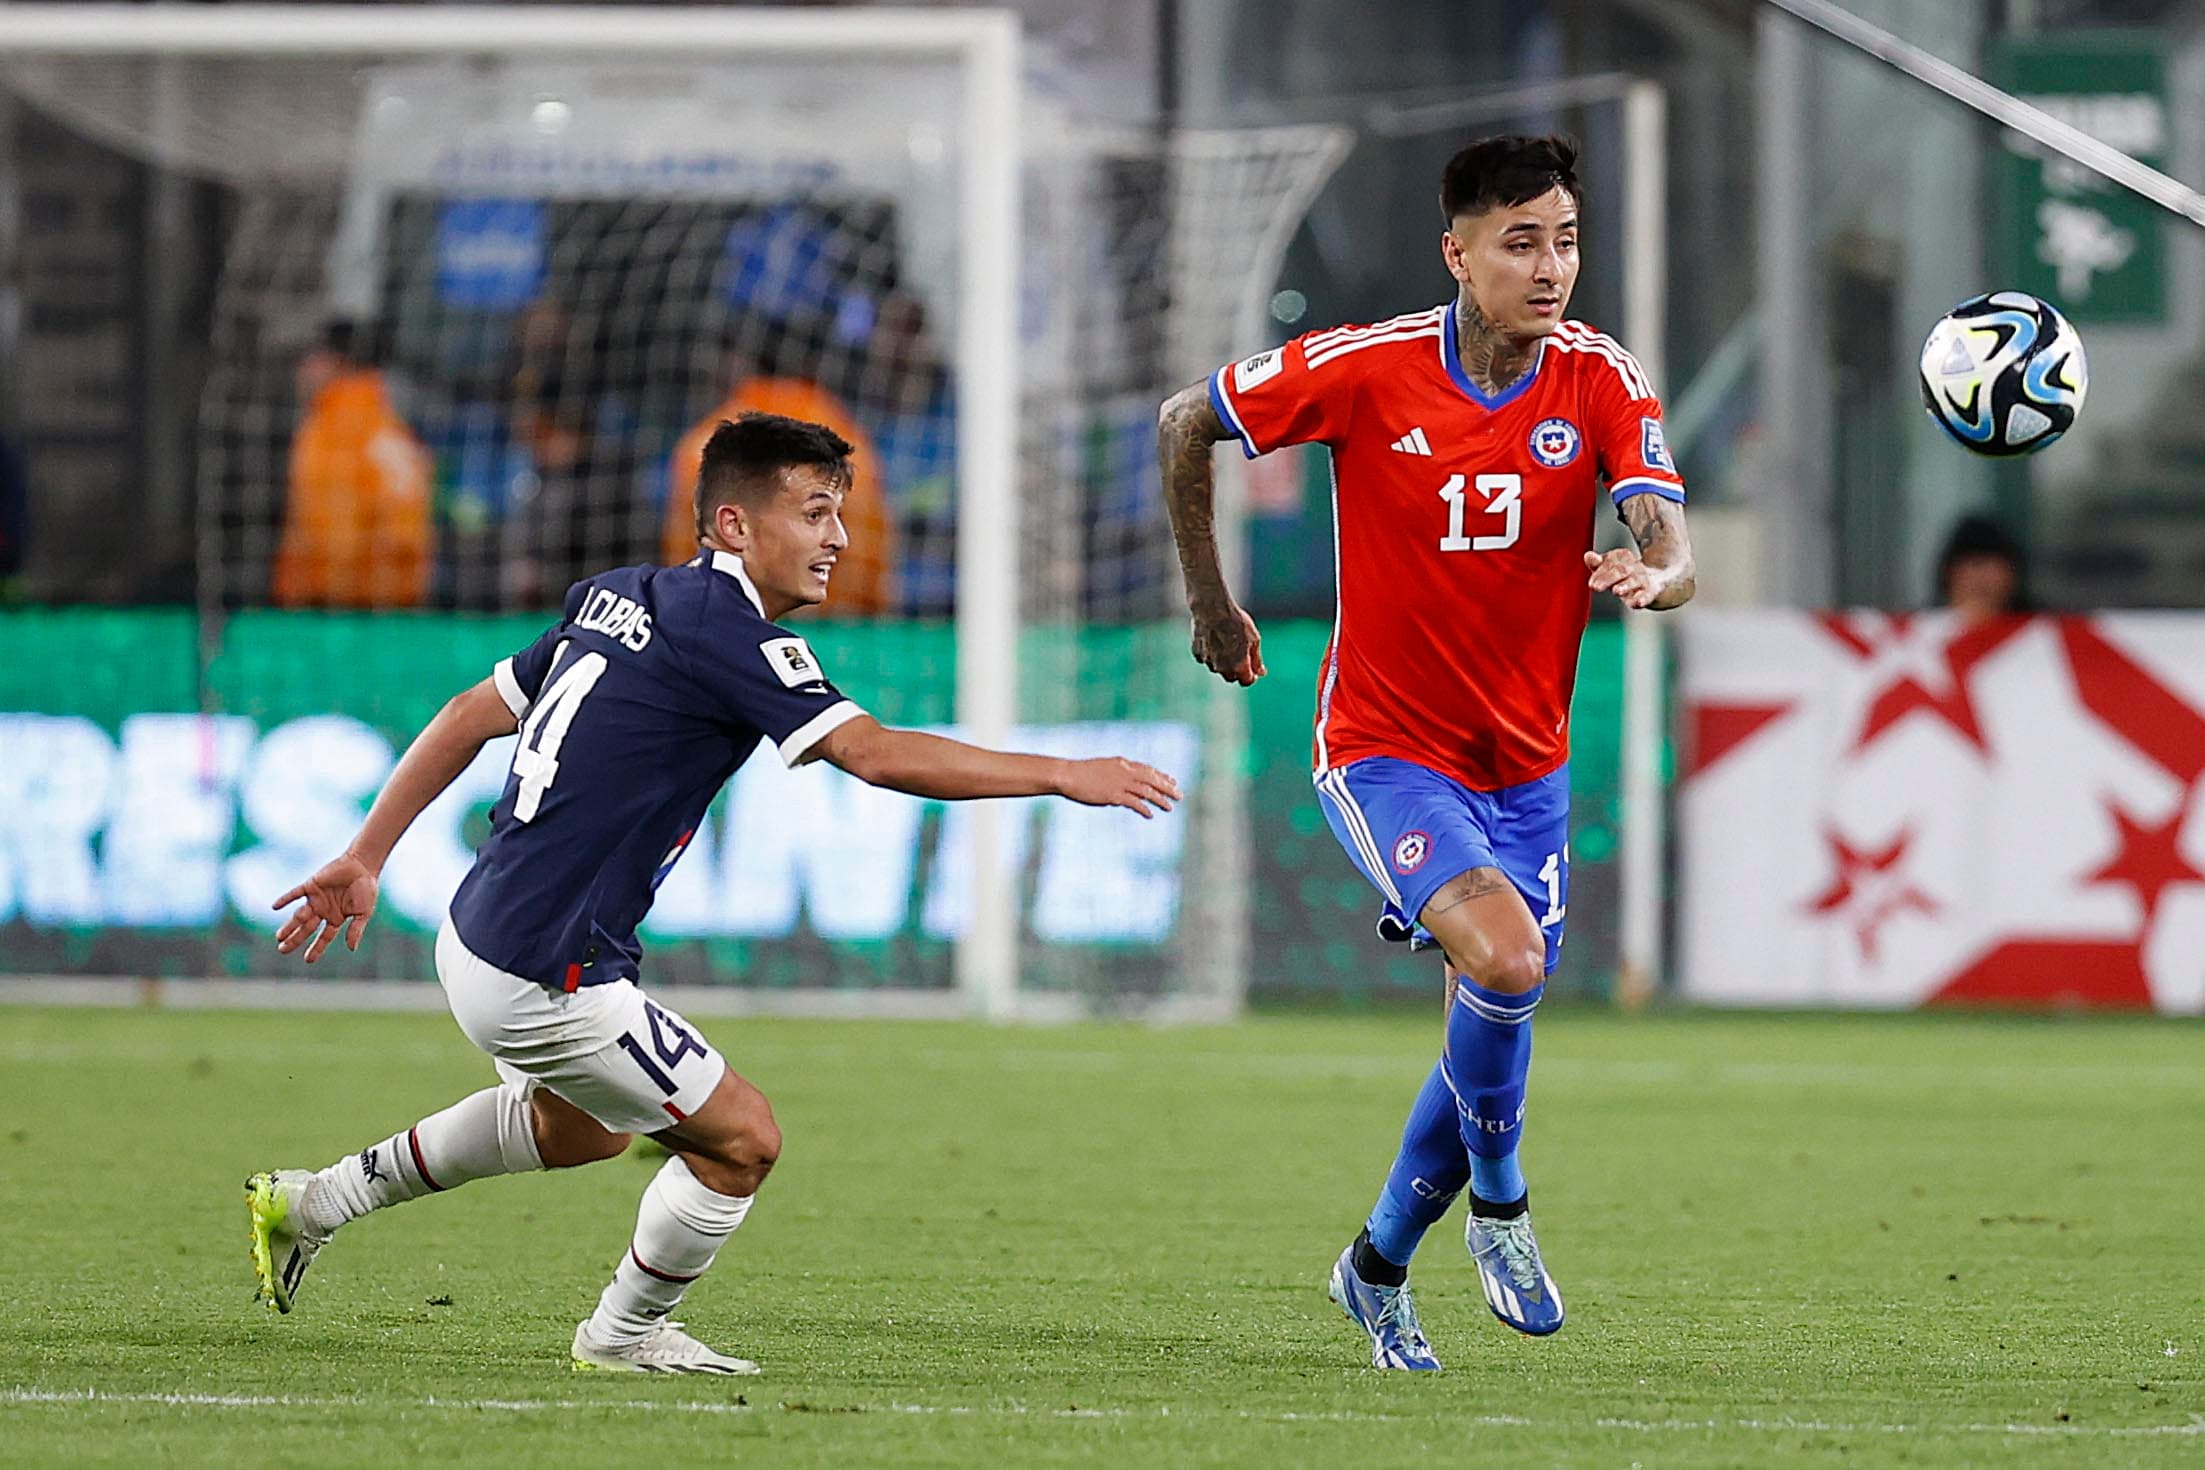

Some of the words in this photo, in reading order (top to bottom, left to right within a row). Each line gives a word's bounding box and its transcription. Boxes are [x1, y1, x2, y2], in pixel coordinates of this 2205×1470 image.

[1438, 473, 1521, 551] 13
[1538, 841, 1569, 928] 1
[616, 999, 708, 1097] 14
